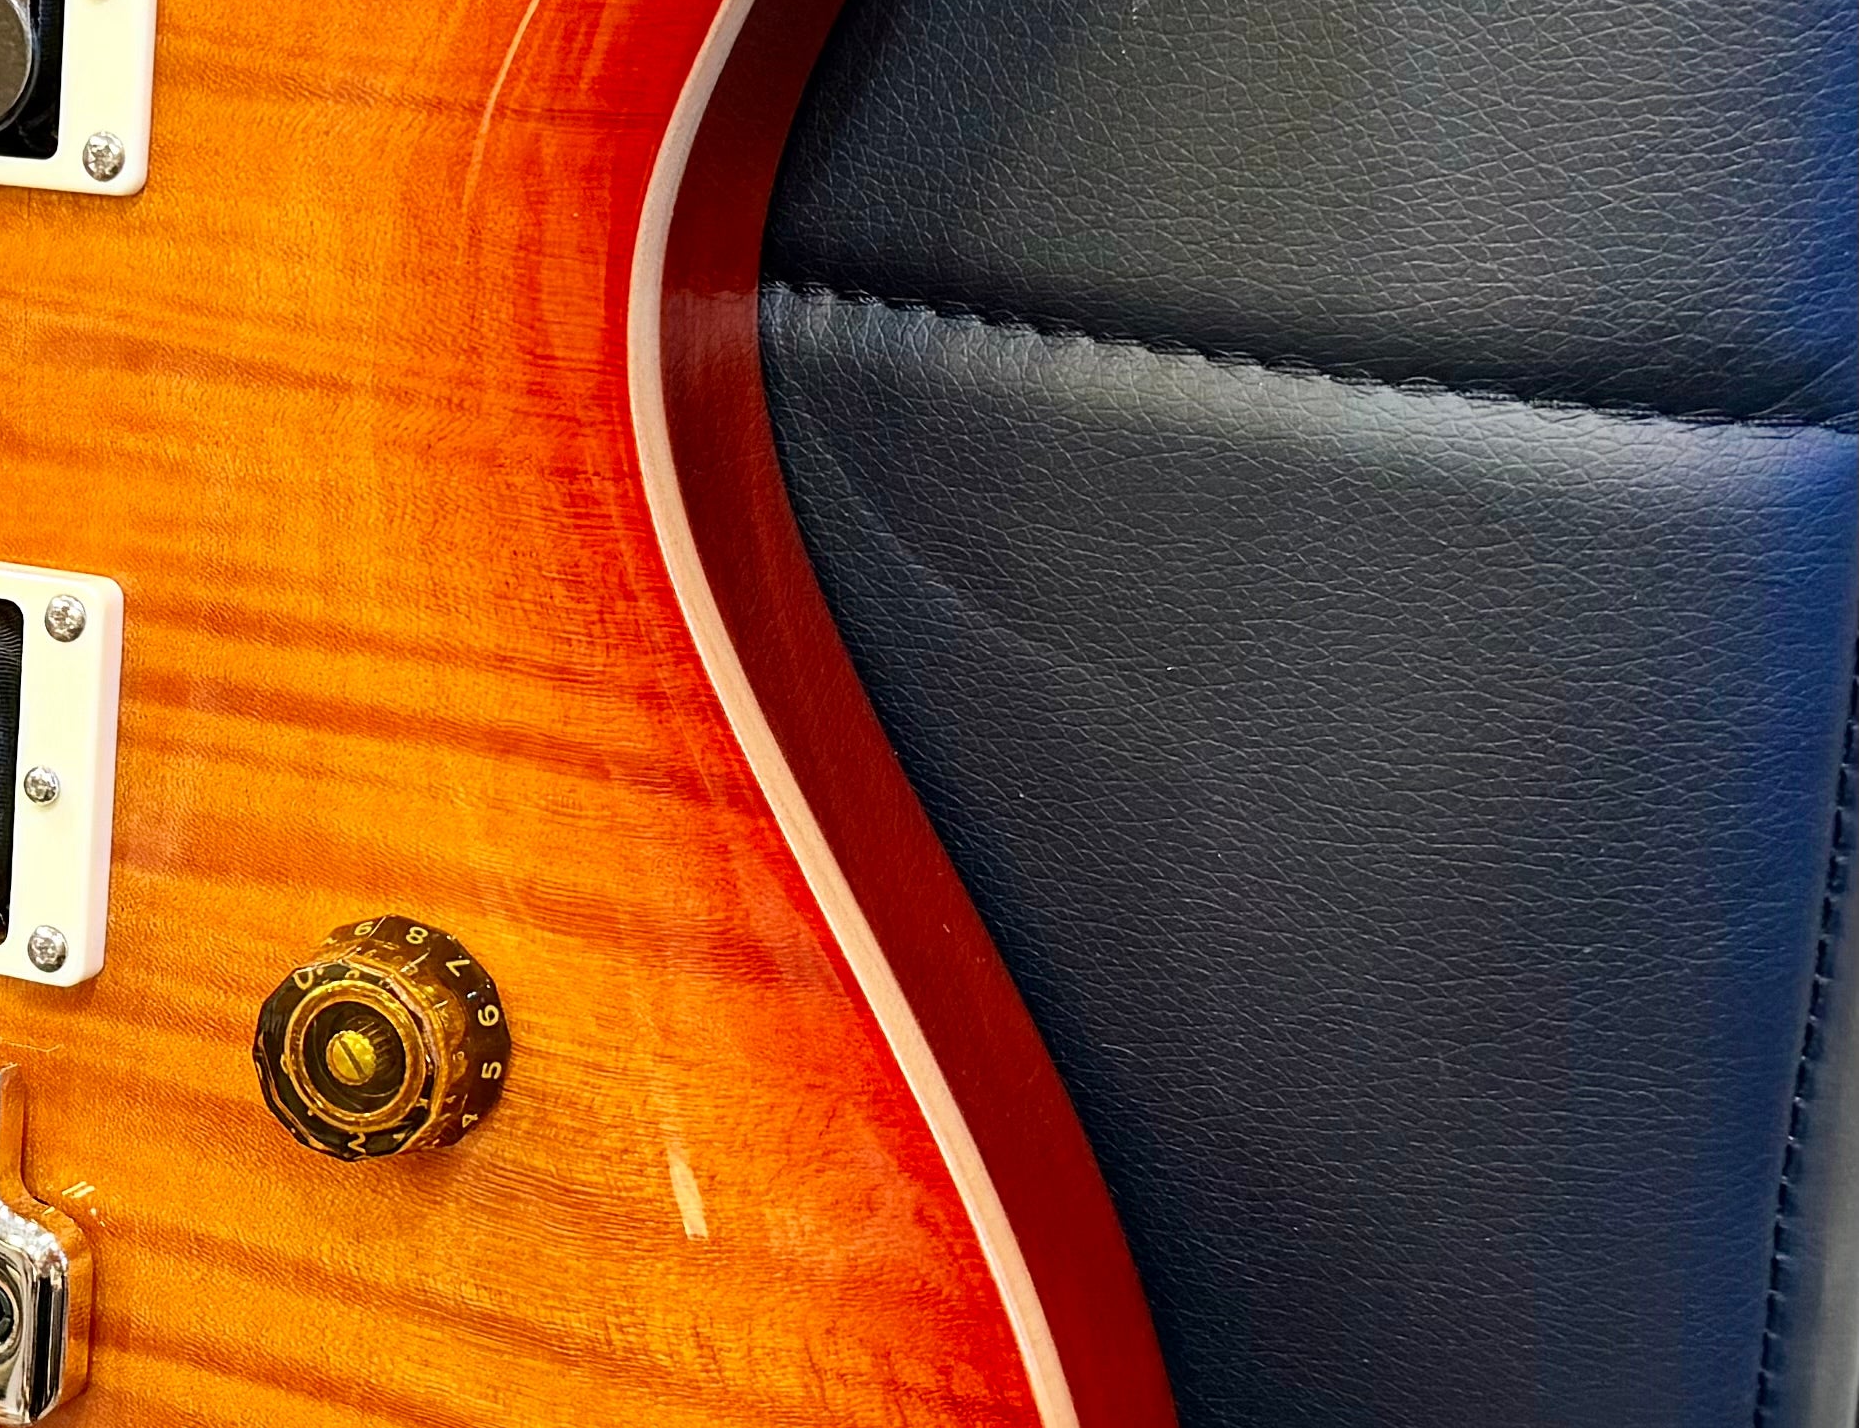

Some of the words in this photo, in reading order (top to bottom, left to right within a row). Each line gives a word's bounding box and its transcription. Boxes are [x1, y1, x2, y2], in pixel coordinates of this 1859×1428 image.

[405, 926, 429, 945] 8
[445, 957, 471, 978] 7
[480, 1060, 503, 1081] 5
